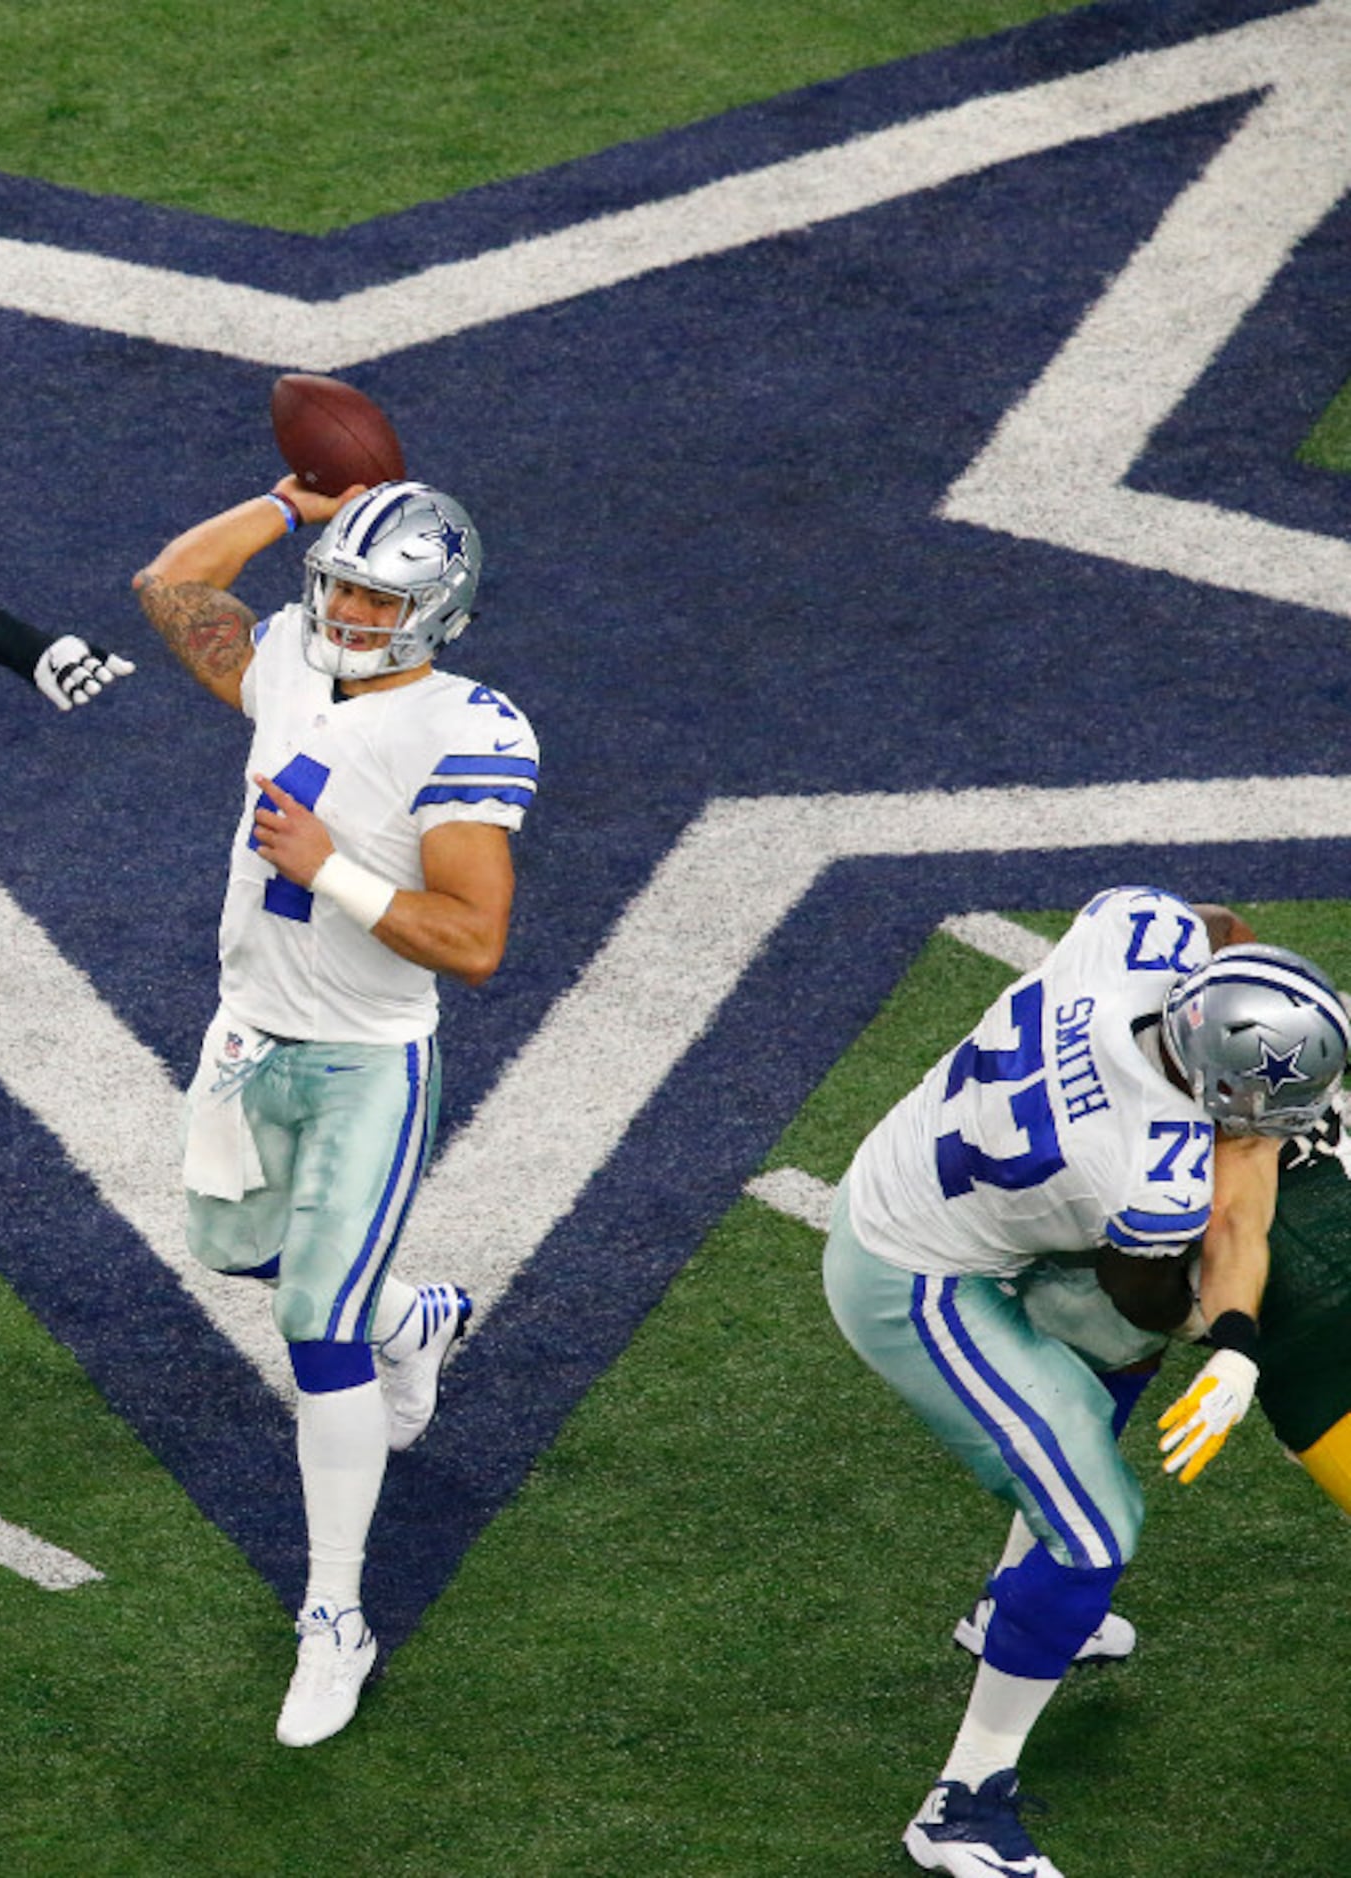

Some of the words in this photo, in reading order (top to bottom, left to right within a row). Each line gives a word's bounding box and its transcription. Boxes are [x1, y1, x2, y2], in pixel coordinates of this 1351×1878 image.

[467, 685, 518, 721] 4
[936, 979, 1067, 1200] 77
[1056, 996, 1111, 1123] SMITH
[1146, 1121, 1213, 1182] 77
